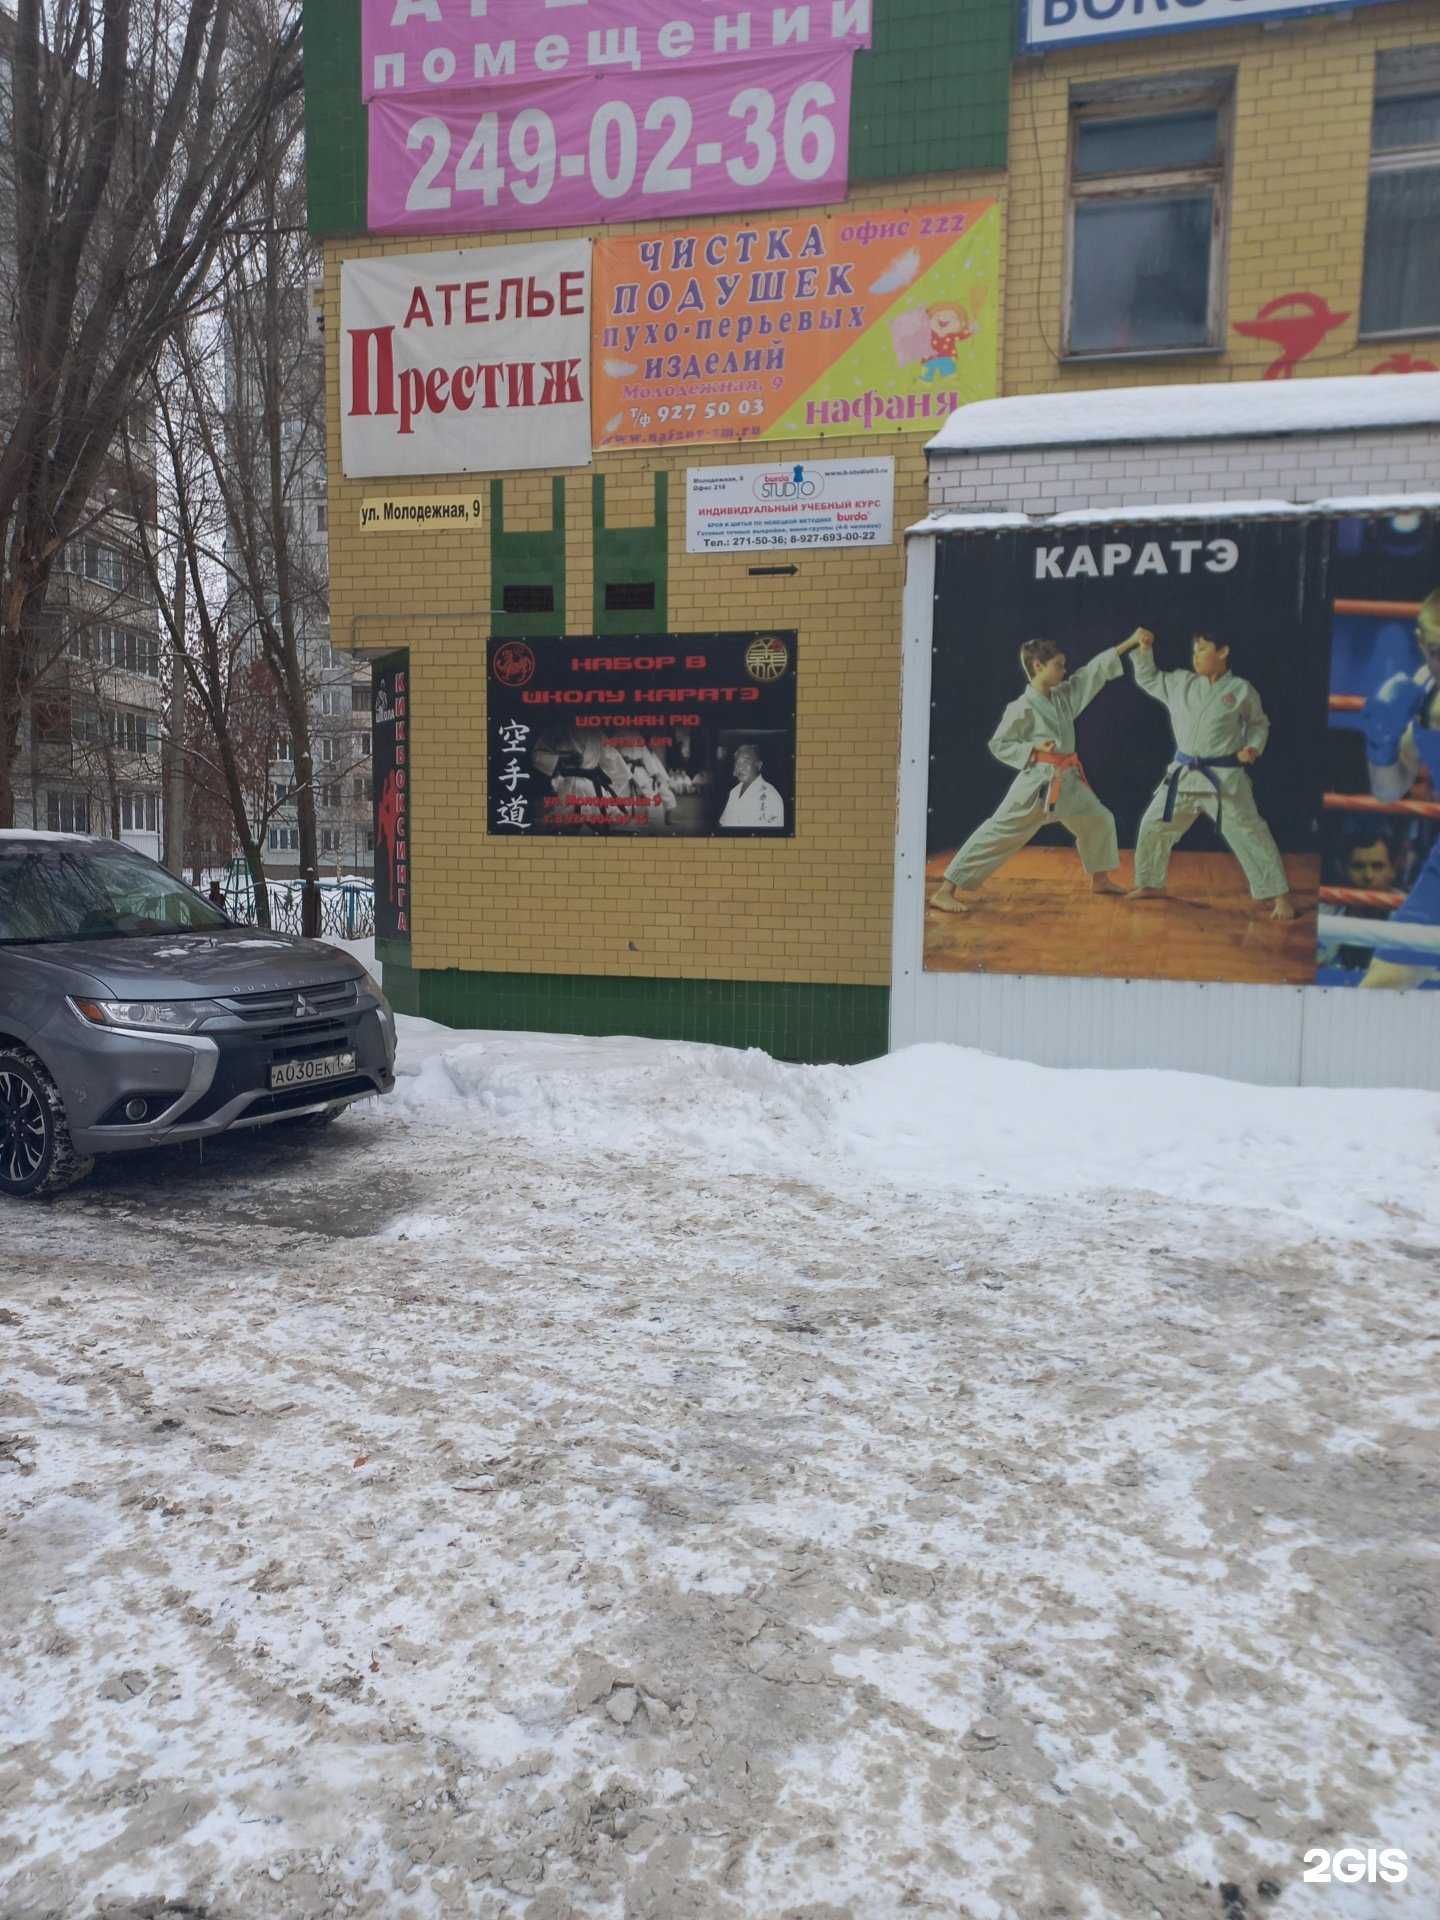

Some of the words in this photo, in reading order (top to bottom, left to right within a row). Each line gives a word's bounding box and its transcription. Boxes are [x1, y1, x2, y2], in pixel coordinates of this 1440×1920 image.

[374, 0, 870, 89] помещений
[405, 81, 836, 211] 249-02-36
[638, 224, 825, 272] ЧИСТКА
[840, 220, 910, 246] офис
[919, 214, 966, 236] 222
[403, 271, 585, 328] АТЕЛЬЕ
[612, 264, 855, 315] ПОДУШЕК
[602, 306, 865, 351] пухо-перьевых
[347, 325, 584, 434] Престиж
[643, 341, 785, 381] изделий
[772, 376, 784, 391] 9
[657, 404, 697, 423] 927
[703, 401, 730, 419] 50
[738, 399, 765, 416] 03
[806, 388, 958, 429] нафаня
[698, 504, 798, 517] ИНДИВИДУАЛЬНЫЙ
[801, 500, 853, 512] УЧЕБНЫЙ
[855, 499, 881, 509] КУРС
[761, 481, 816, 498] STUDIO
[361, 507, 380, 525] ул.
[383, 502, 469, 522] Молодежная,
[472, 499, 481, 518] 9
[704, 538, 730, 547] Тел.:
[1034, 539, 1240, 580] КАРАТЭ
[571, 656, 676, 671] НАБОР
[685, 655, 707, 669] В
[521, 689, 627, 704] ШКОЛУ
[634, 687, 760, 704] КАРАТЭ
[497, 719, 532, 829] 空手道
[394, 672, 407, 931] КИКБОКСИНГА
